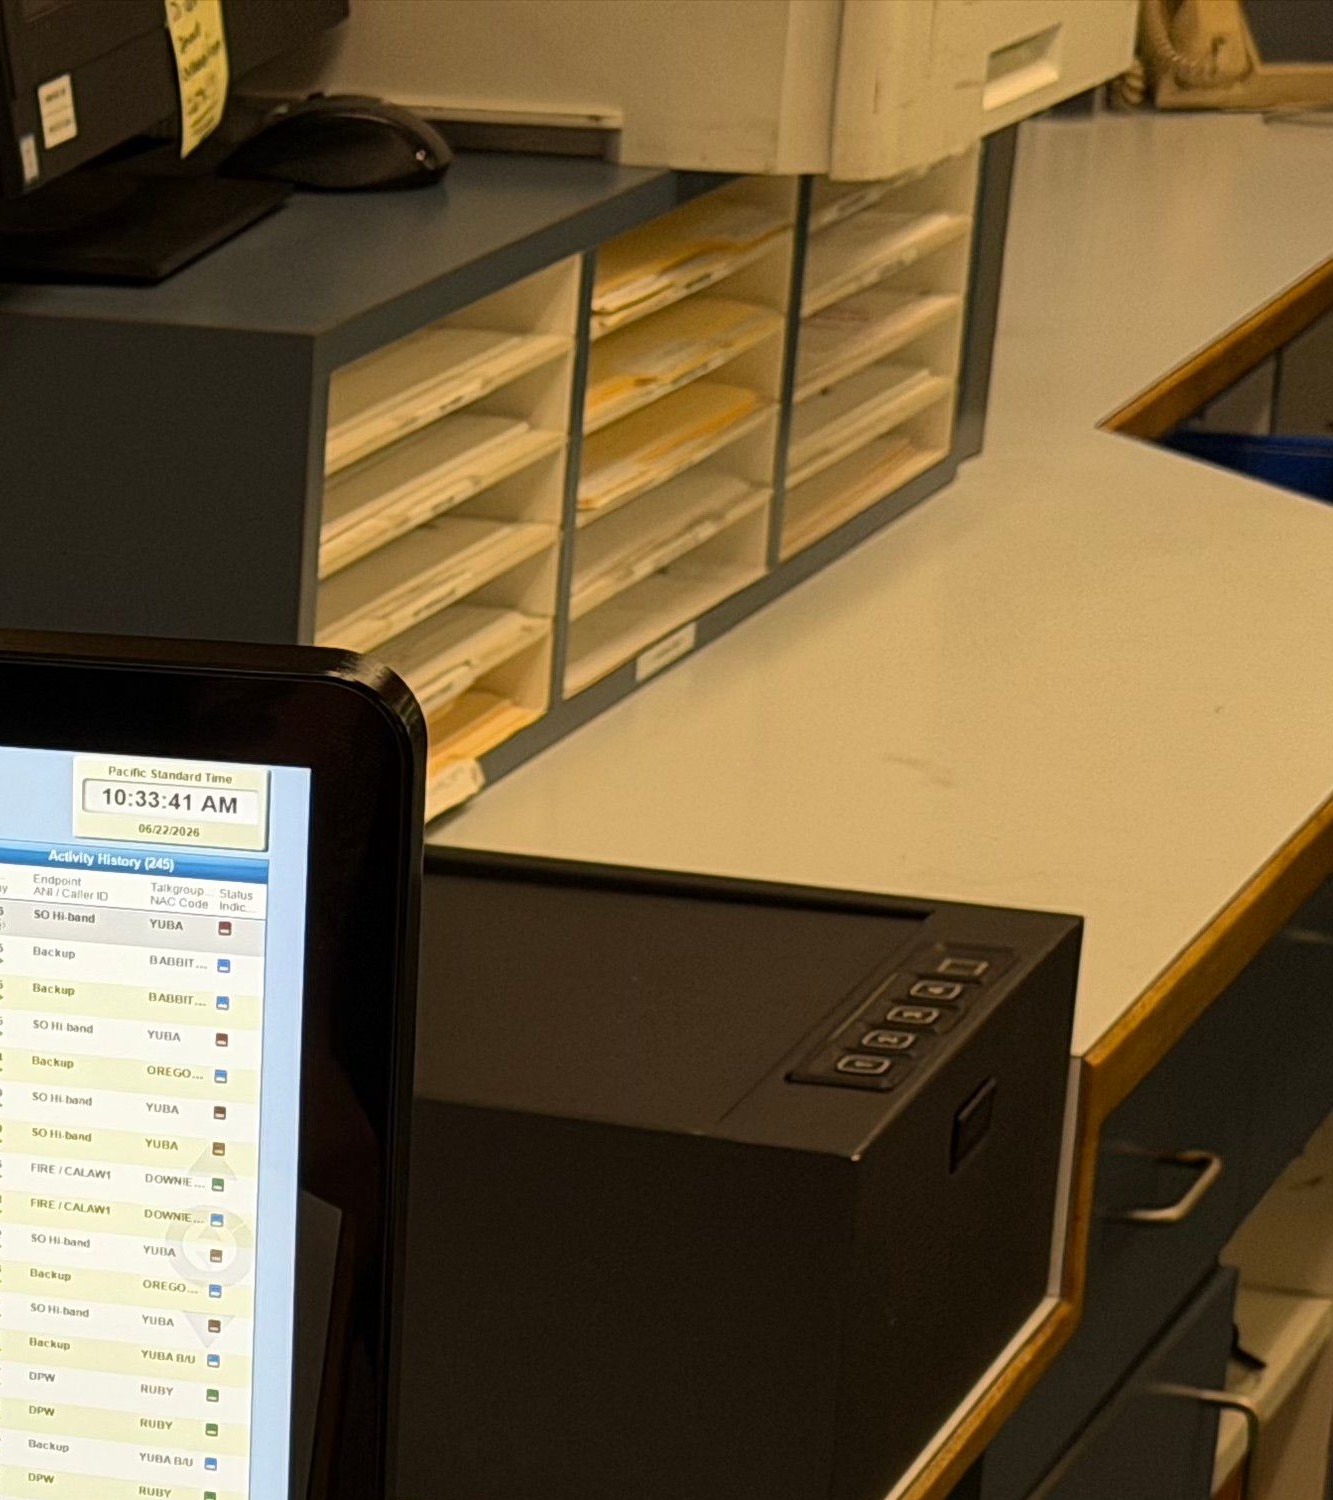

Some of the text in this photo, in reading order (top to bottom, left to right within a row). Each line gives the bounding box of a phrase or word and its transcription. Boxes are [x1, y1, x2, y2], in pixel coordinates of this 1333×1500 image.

[107, 766, 233, 785] Pacific Standard Time
[101, 786, 239, 815] 10:33:41 AM
[138, 823, 201, 838] 06/22/2026
[47, 848, 175, 873] Activity History (245)
[33, 874, 82, 888] Endpoint
[219, 888, 254, 901] Status
[149, 918, 184, 931] YUBA
[32, 946, 76, 961] Backup
[30, 1162, 56, 1175] FIRE
[28, 1405, 55, 1417] DPW
[139, 1418, 173, 1431] RUBY
[27, 1439, 70, 1454] Backup
[27, 1472, 55, 1485] DPW
[138, 1486, 172, 1499] RUBY
